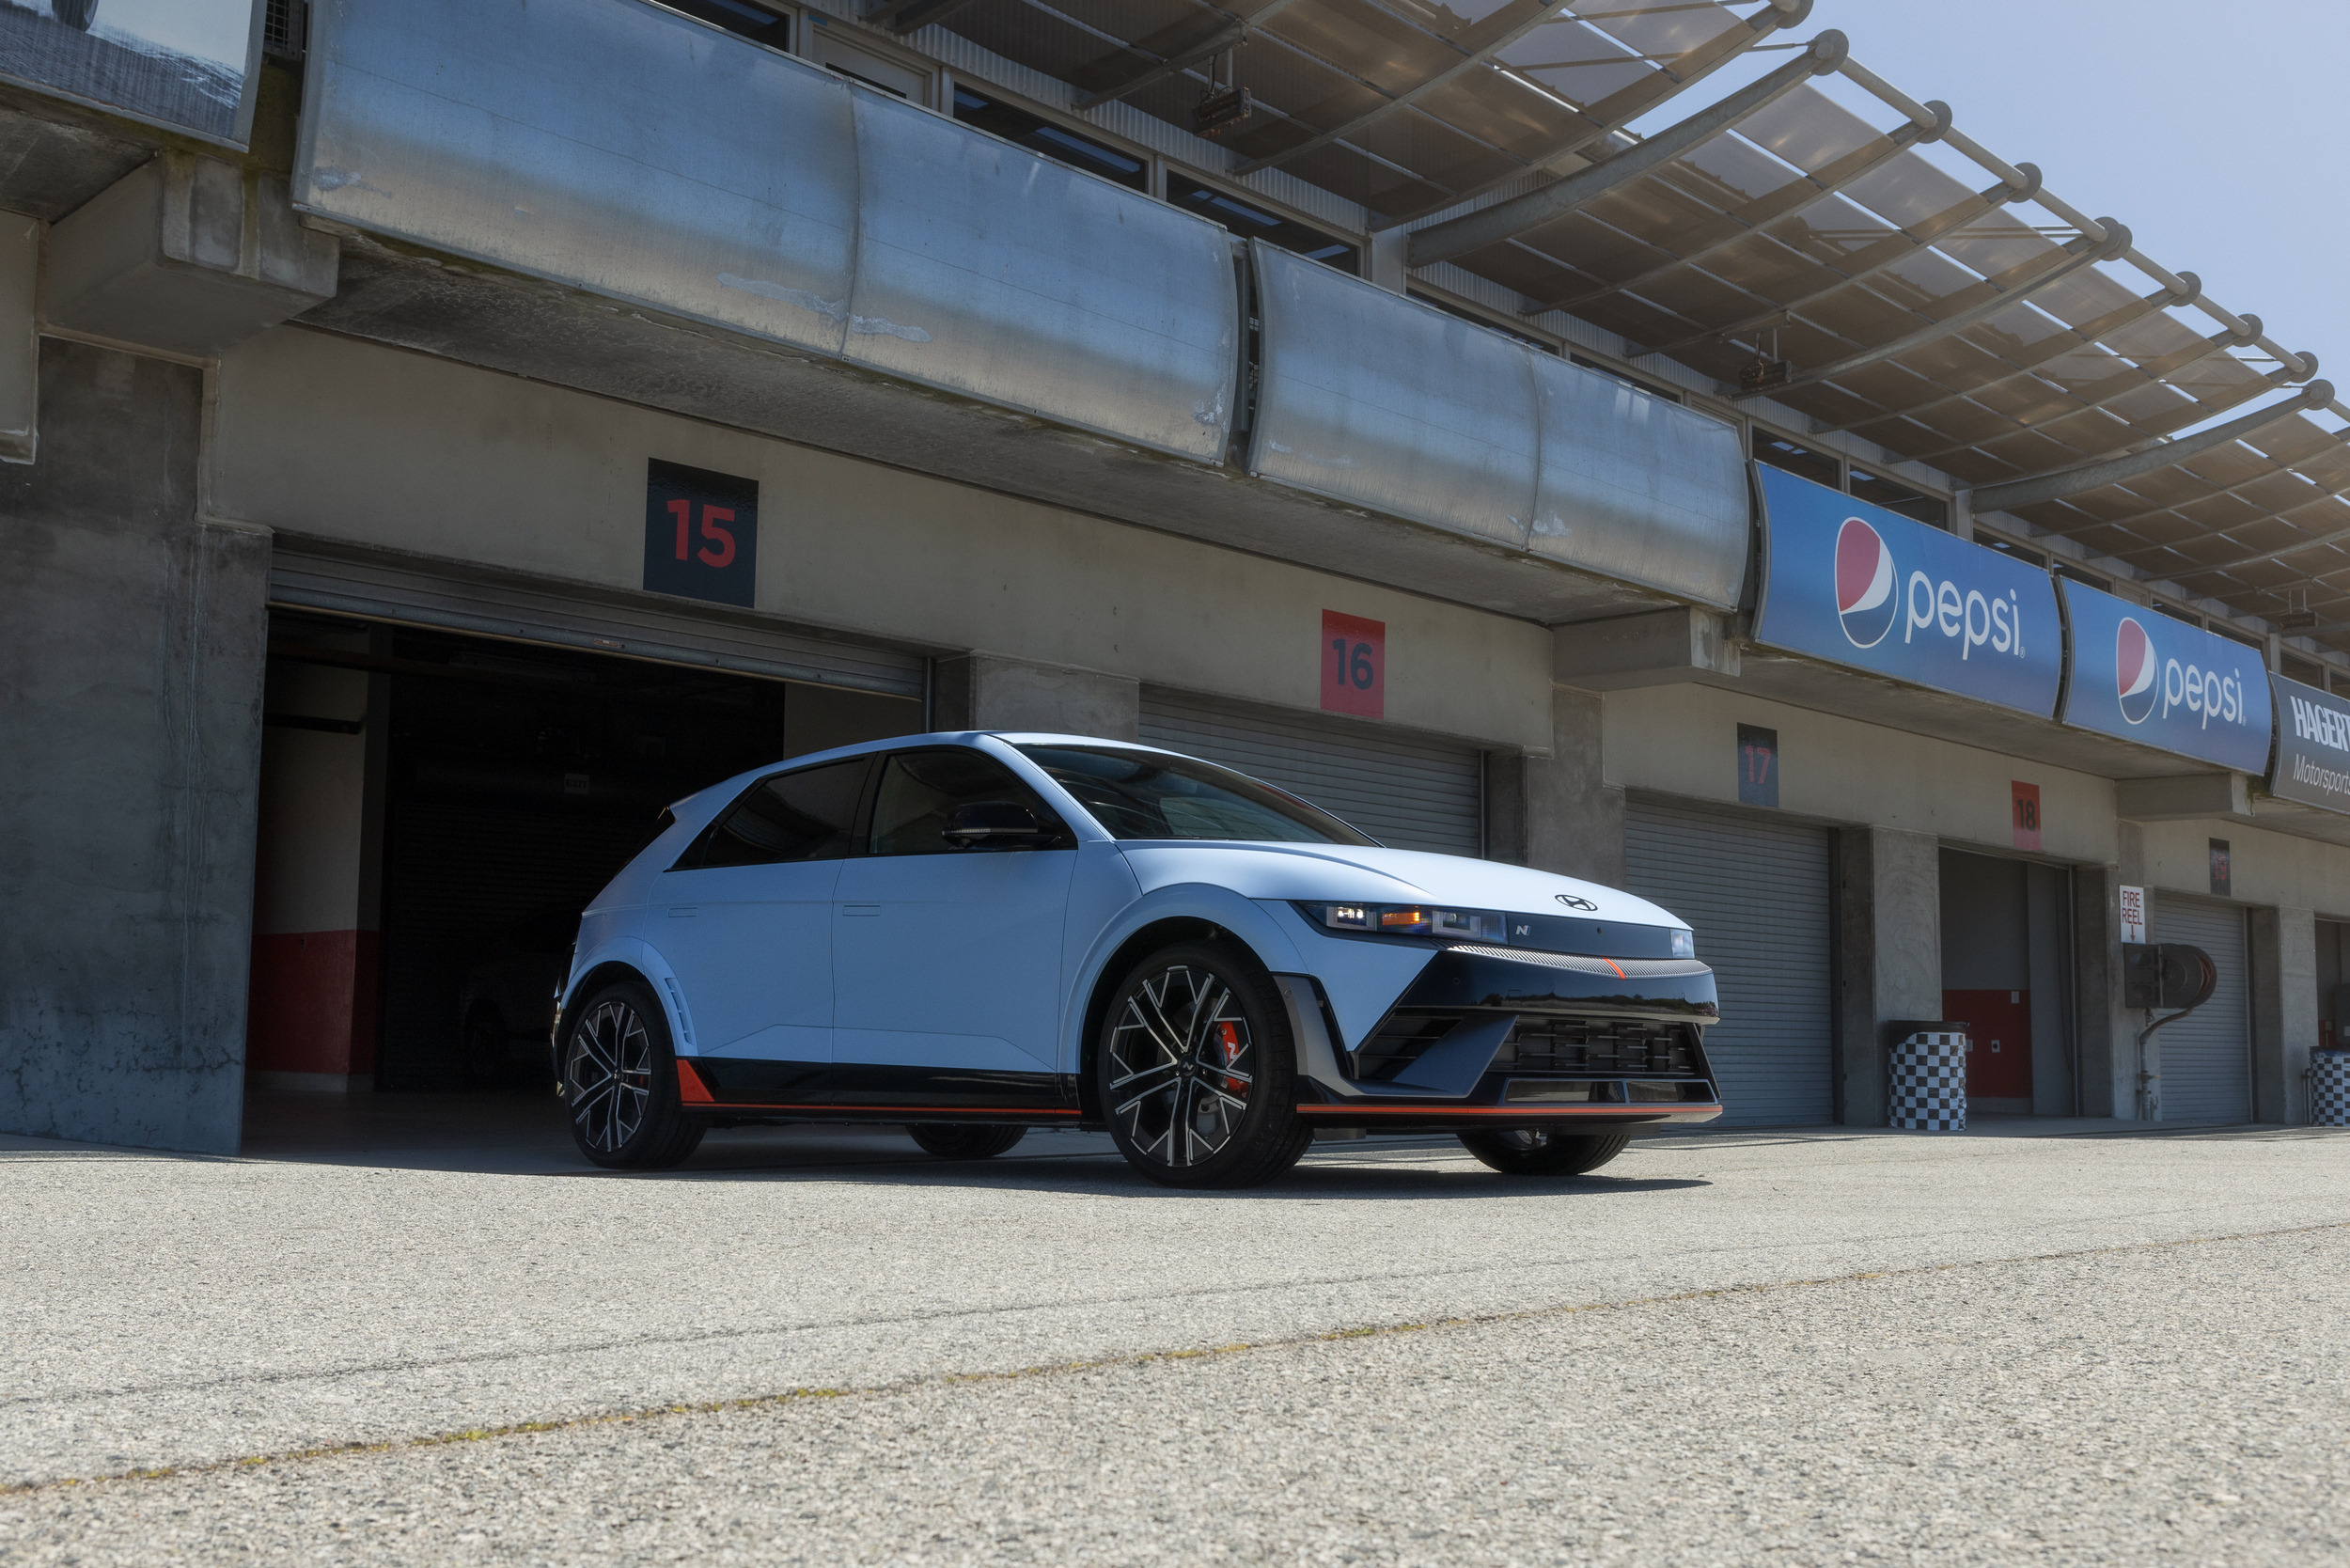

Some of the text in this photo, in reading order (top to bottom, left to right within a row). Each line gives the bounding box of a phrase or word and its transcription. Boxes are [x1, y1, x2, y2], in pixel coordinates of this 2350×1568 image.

[666, 498, 736, 568] 15
[1904, 570, 2020, 661] pepsi
[1332, 637, 1374, 690] 16
[2162, 658, 2243, 730] pepsi
[1745, 745, 1771, 784] 17
[566, 778, 588, 789] EXIT
[2017, 799, 2036, 832] 18
[2213, 853, 2227, 880] 19
[2122, 907, 2142, 925] REEL
[2123, 890, 2140, 908] FIRE
